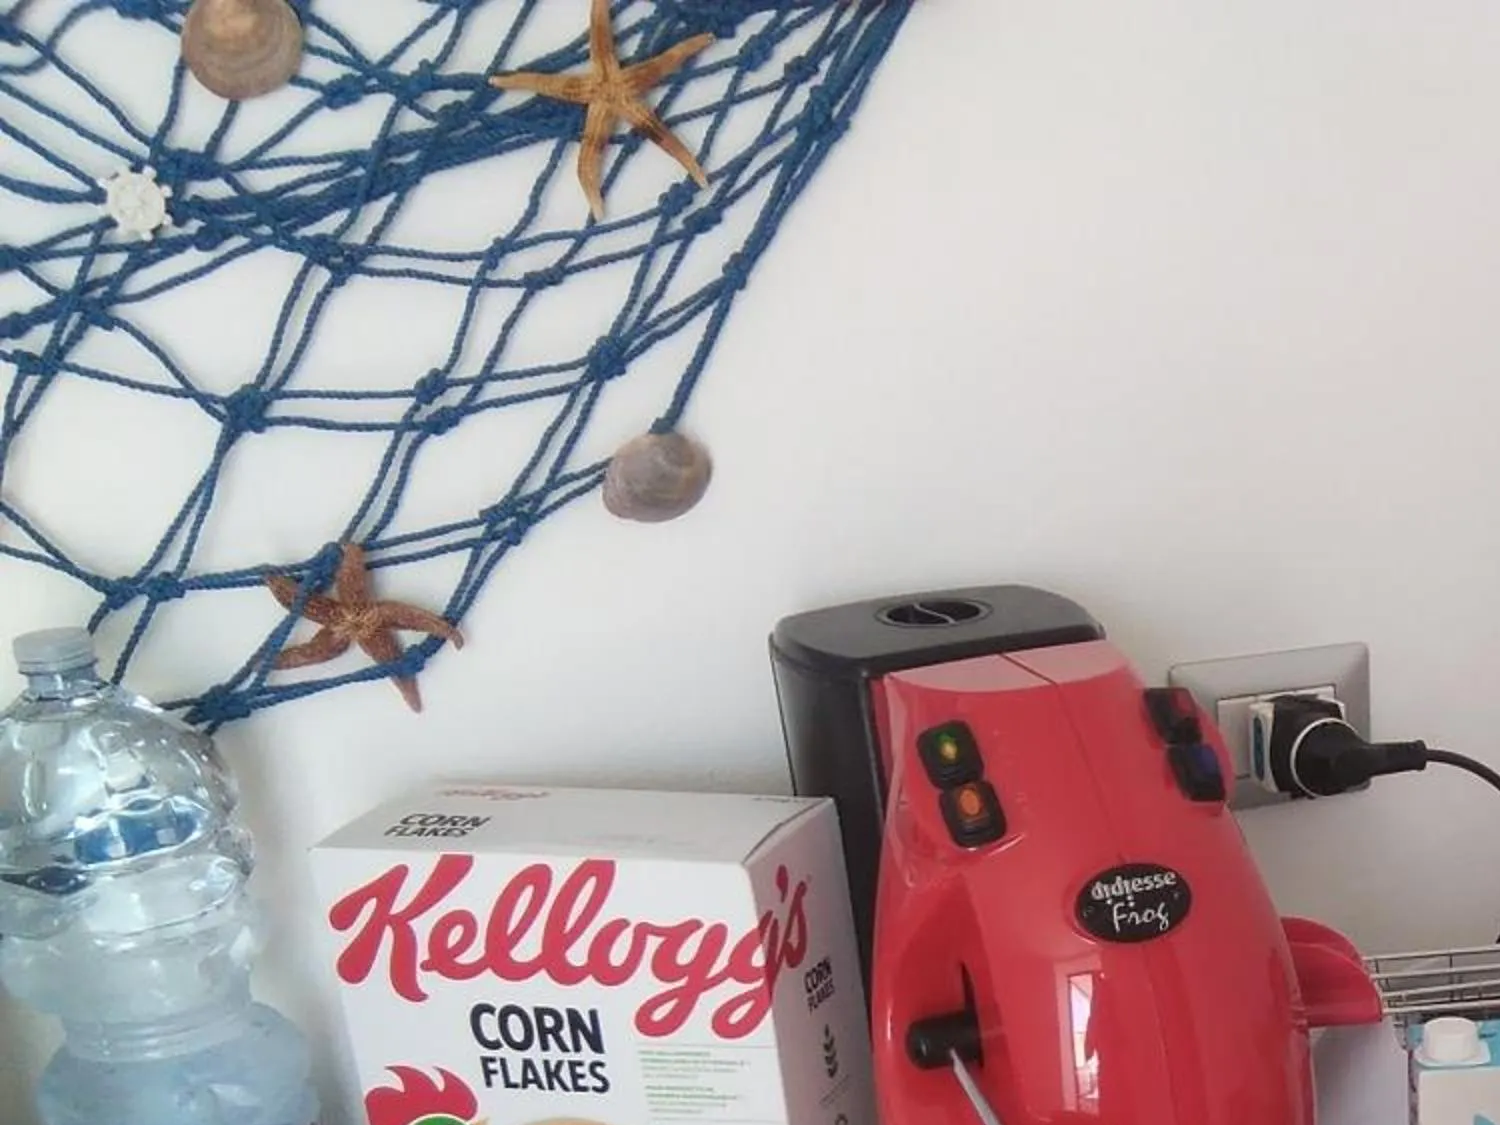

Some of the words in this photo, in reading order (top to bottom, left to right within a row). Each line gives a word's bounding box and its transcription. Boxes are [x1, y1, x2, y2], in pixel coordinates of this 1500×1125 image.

[401, 813, 492, 827] CORN
[1113, 902, 1169, 932] Frog
[329, 854, 808, 1039] Kellogg's
[470, 1003, 604, 1054] CORN
[480, 1055, 610, 1094] FLAKES
